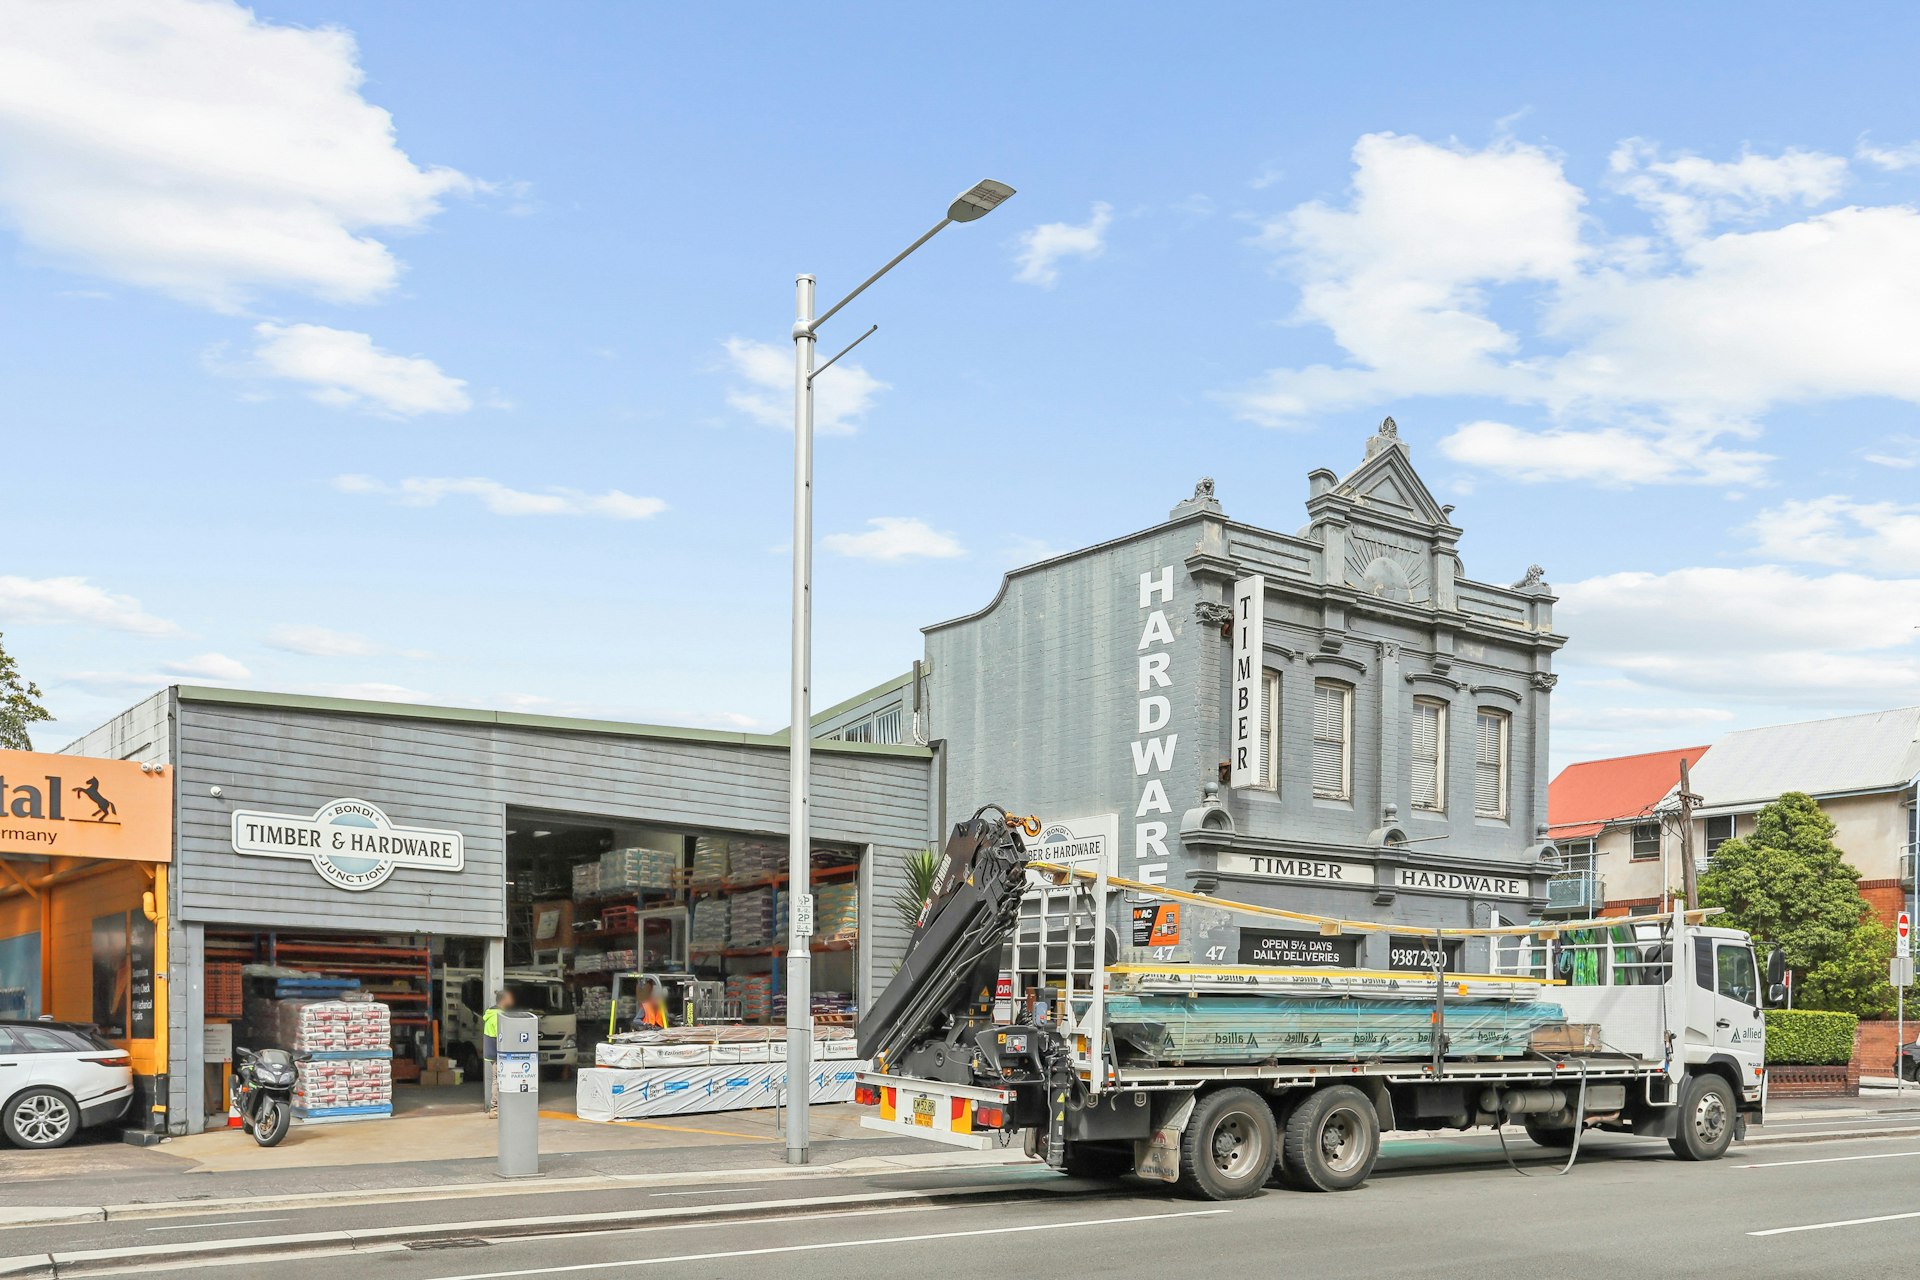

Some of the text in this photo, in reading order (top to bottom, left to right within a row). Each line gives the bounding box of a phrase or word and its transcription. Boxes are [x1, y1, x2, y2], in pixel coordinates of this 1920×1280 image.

[1237, 595, 1251, 771] TIMBER
[1131, 565, 1178, 900] HARDWARE
[335, 806, 374, 819] BONDI
[0, 829, 58, 845] rmany
[1047, 828, 1067, 837] BONDI
[246, 823, 453, 859] TIMBER & HARDWARE
[1028, 841, 1101, 861] BER & HARDWARE
[320, 860, 386, 883] JUNCTION
[1249, 856, 1520, 895] TIMBER HARDWARE
[798, 914, 810, 922] 2P
[1133, 909, 1152, 919] MAC
[1262, 939, 1289, 950] OPEN
[1309, 941, 1333, 951] DAYS
[1153, 946, 1176, 961] 47
[1206, 946, 1227, 961] 47
[1253, 950, 1340, 963] DAILY DELIVERIES
[1391, 949, 1420, 966] 9387
[1743, 1027, 1762, 1039] allied
